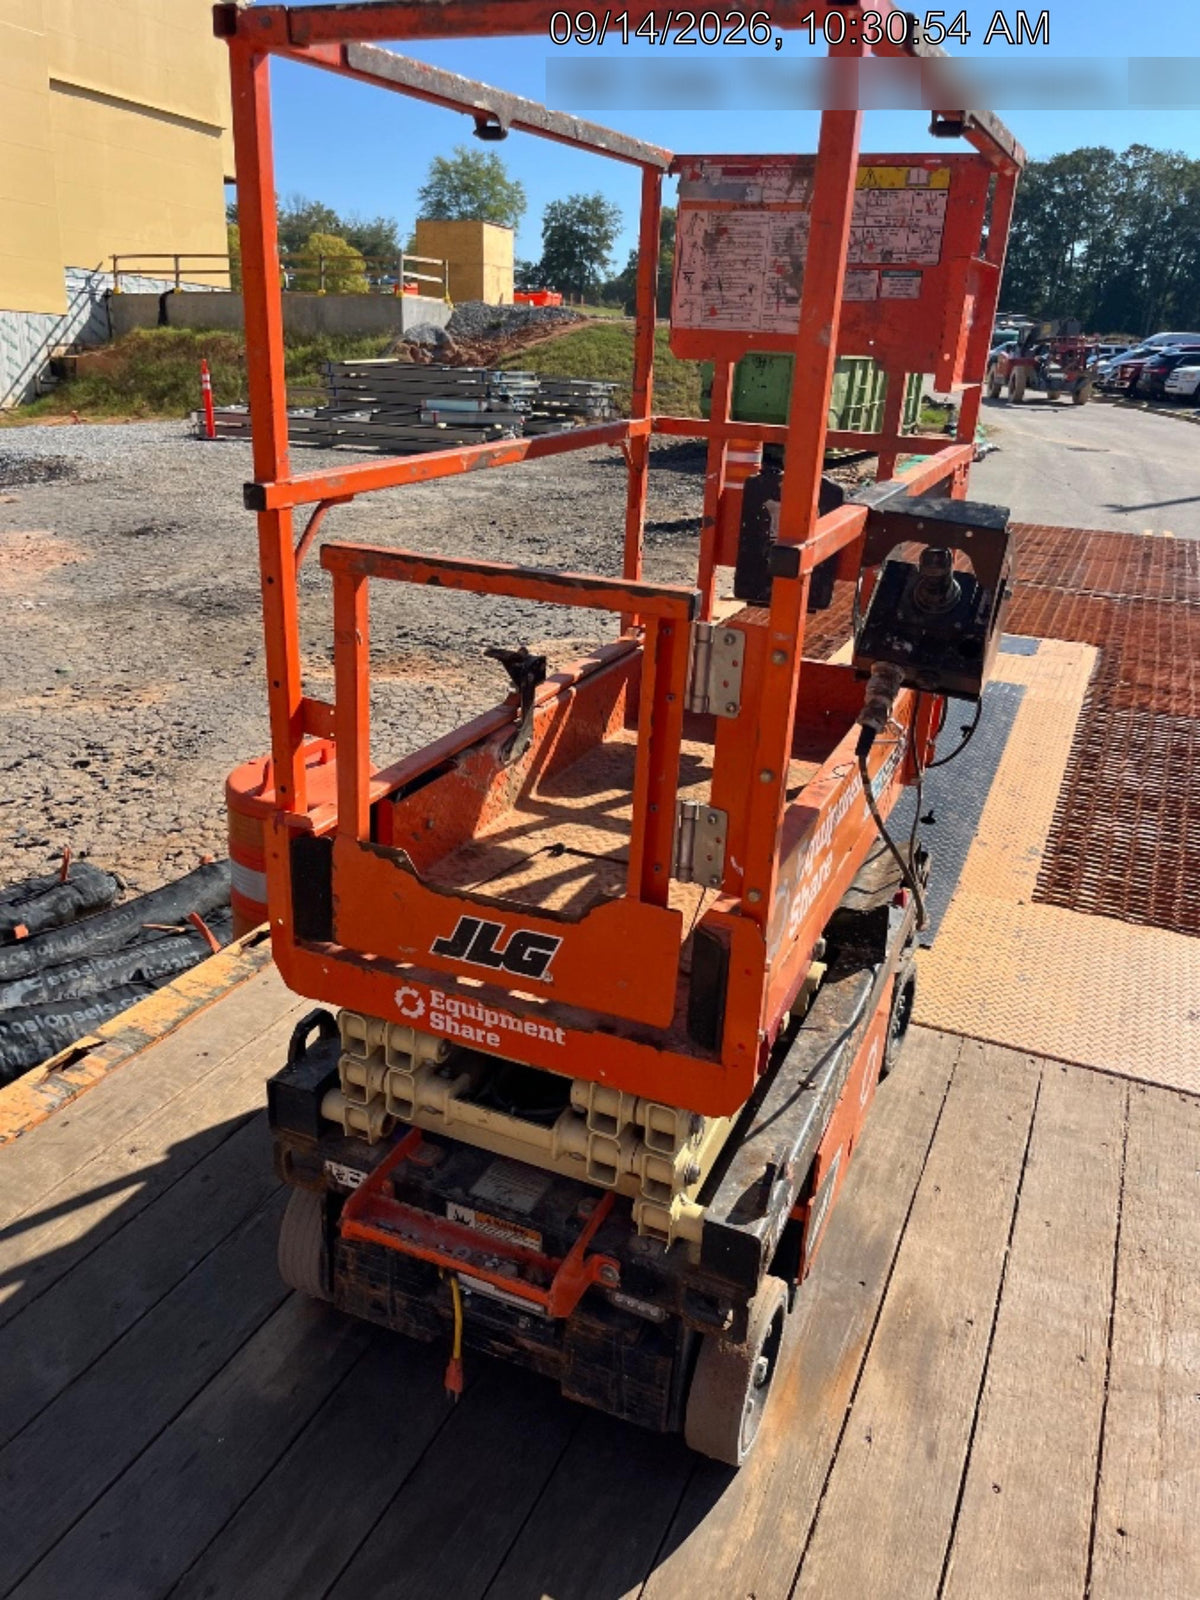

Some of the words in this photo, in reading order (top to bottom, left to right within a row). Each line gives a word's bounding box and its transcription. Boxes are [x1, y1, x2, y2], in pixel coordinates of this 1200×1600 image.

[429, 914, 564, 981] JLG
[429, 1010, 501, 1048] Share
[430, 989, 566, 1046] Equipment
